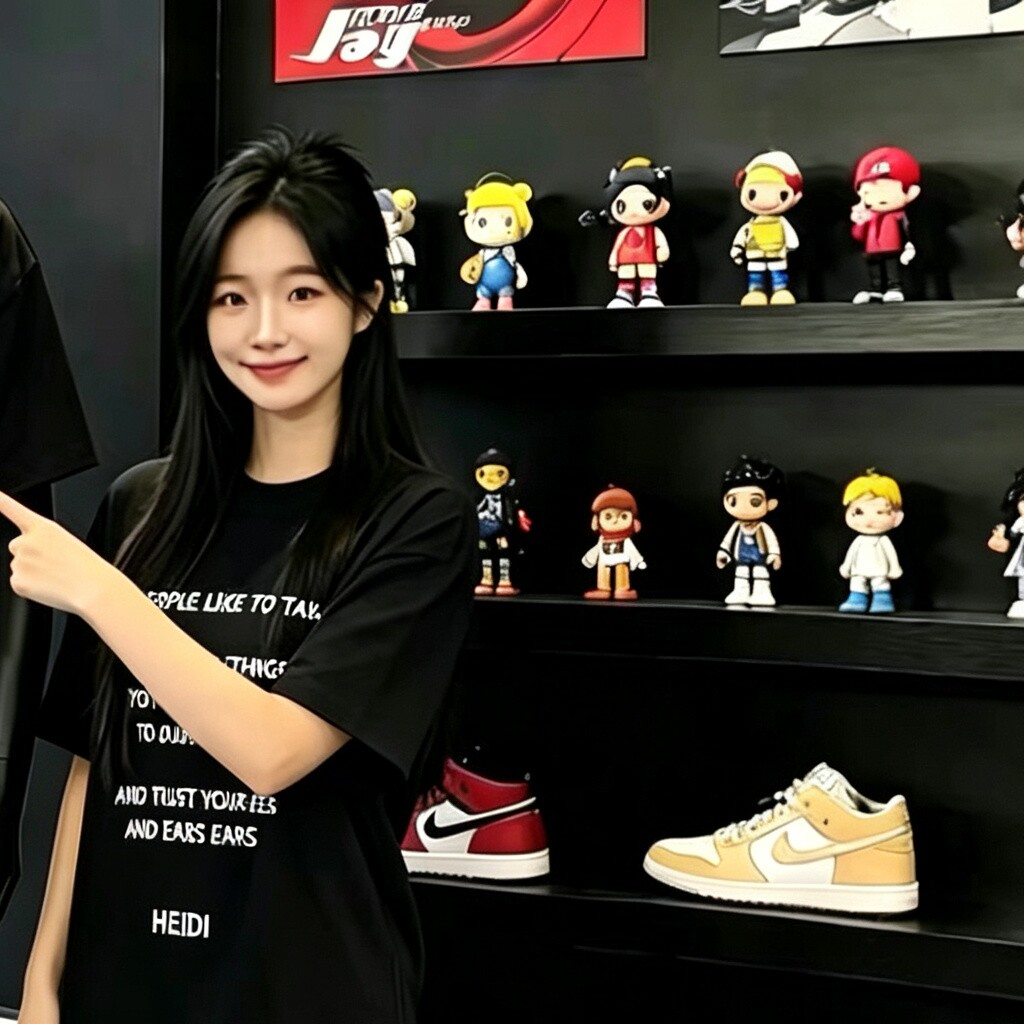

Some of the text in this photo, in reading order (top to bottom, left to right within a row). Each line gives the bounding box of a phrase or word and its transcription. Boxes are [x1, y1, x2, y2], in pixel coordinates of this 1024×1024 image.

[250, 593, 277, 615] TO
[136, 722, 156, 743] TO
[114, 785, 148, 806] AND
[124, 818, 258, 848] AND EARS EARS
[151, 908, 210, 939] HEIDI
